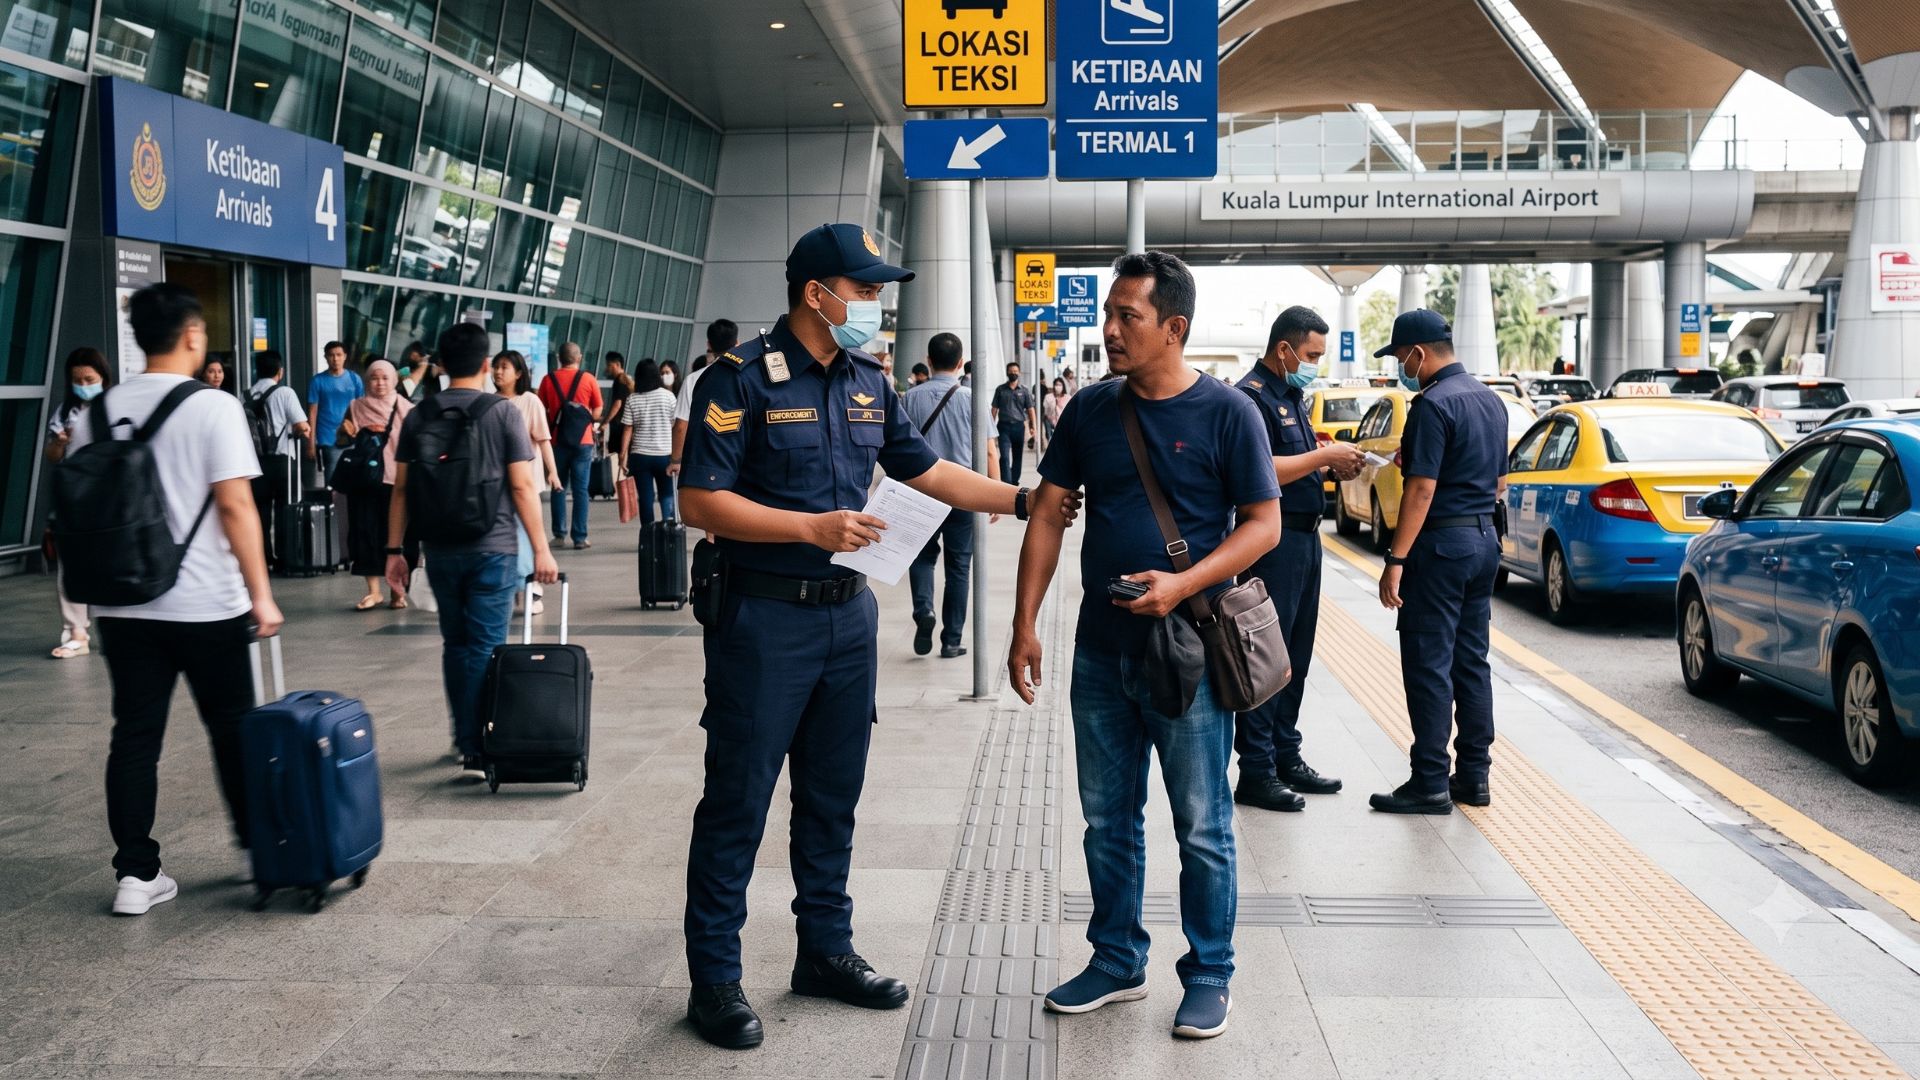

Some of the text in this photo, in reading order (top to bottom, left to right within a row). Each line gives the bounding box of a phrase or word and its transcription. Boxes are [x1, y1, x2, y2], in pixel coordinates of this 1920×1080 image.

[921, 30, 1028, 57] LOKASI
[932, 65, 1017, 91] TEKSI
[1072, 59, 1202, 84] KETIBAAN
[1094, 90, 1179, 111] Arrivals
[1077, 131, 1194, 153] TERMAL 1
[206, 138, 280, 189] Ketibaan
[215, 188, 272, 228] Arrivals
[315, 167, 338, 242] 4
[1221, 188, 1599, 213] Kuala Lumpur International Airport
[1020, 280, 1052, 289] LOKASI
[1023, 291, 1048, 299] TEKSI
[1628, 384, 1659, 396] TAXI
